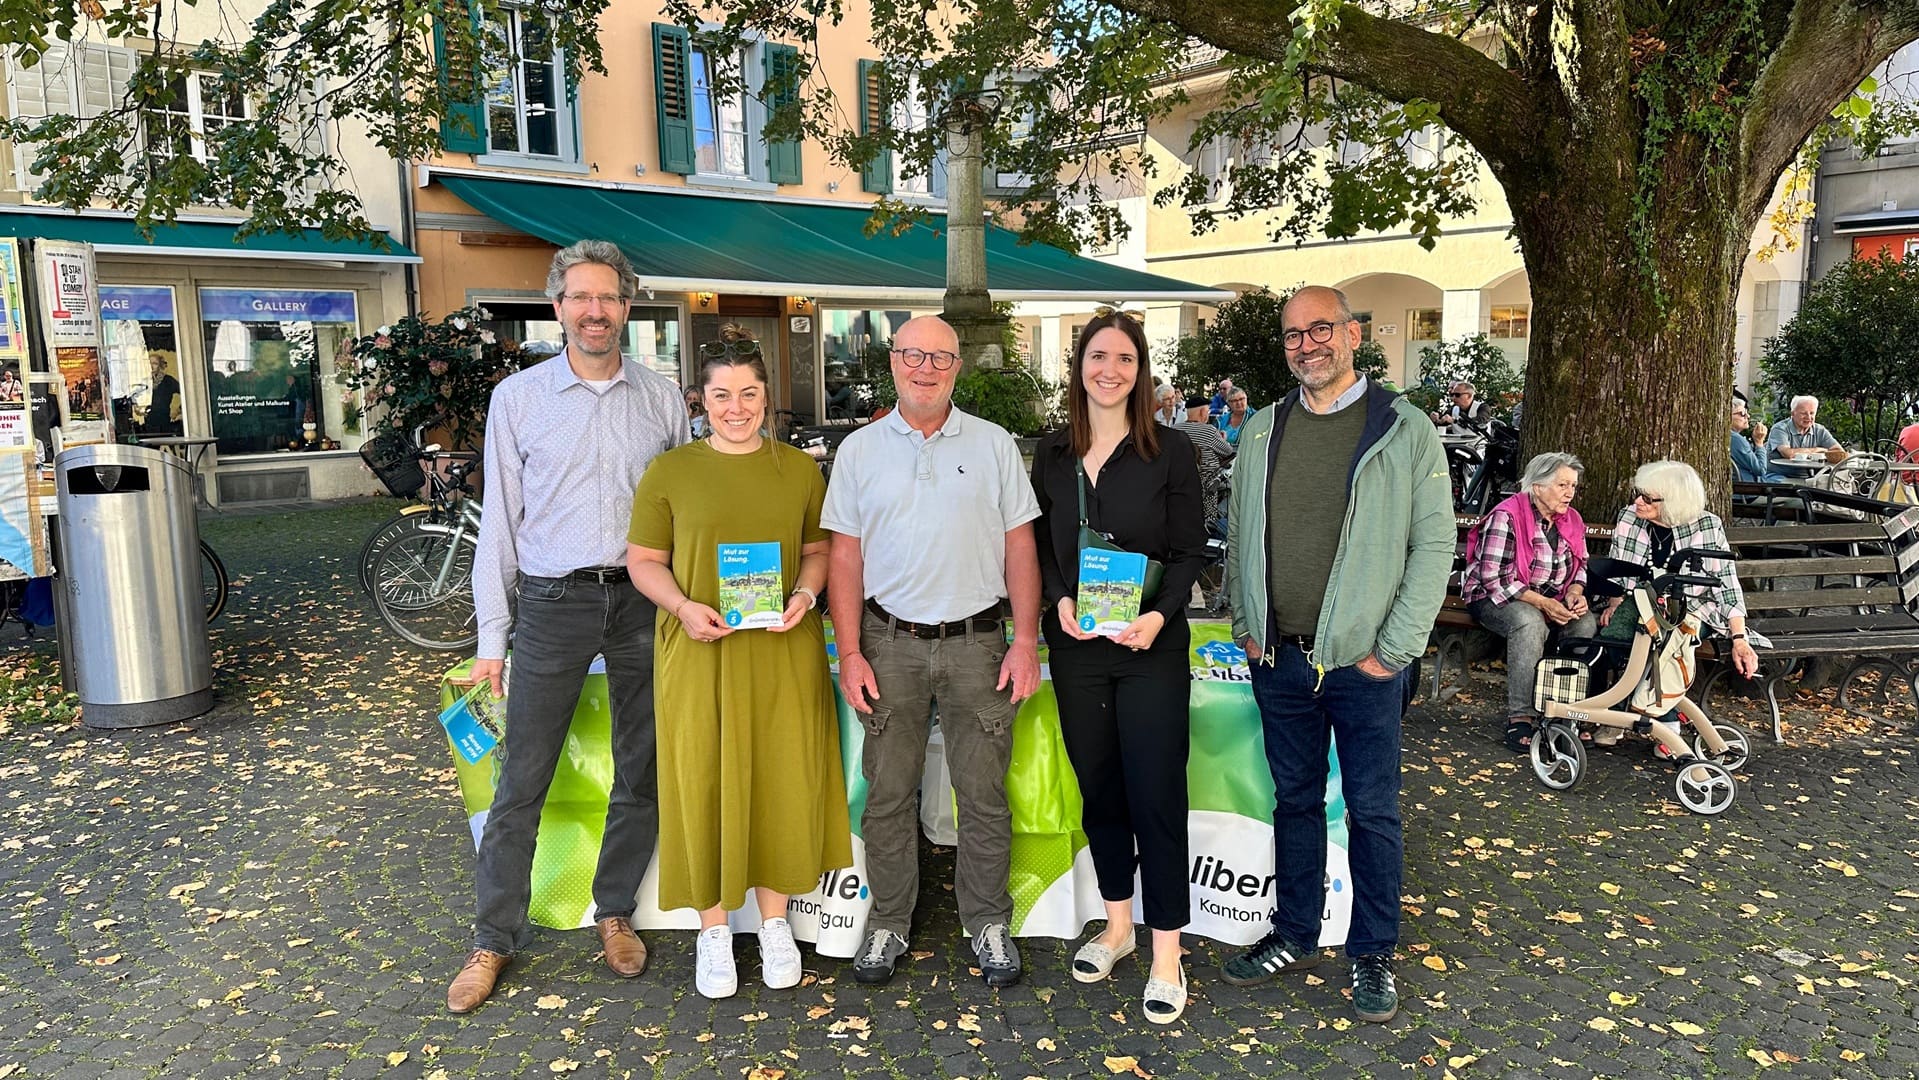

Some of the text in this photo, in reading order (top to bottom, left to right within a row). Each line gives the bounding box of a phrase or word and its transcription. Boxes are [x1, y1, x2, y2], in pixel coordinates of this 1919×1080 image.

[217, 394, 256, 402] Ausstellungen
[730, 616, 737, 625] 5
[1199, 897, 1262, 922] Kanton
